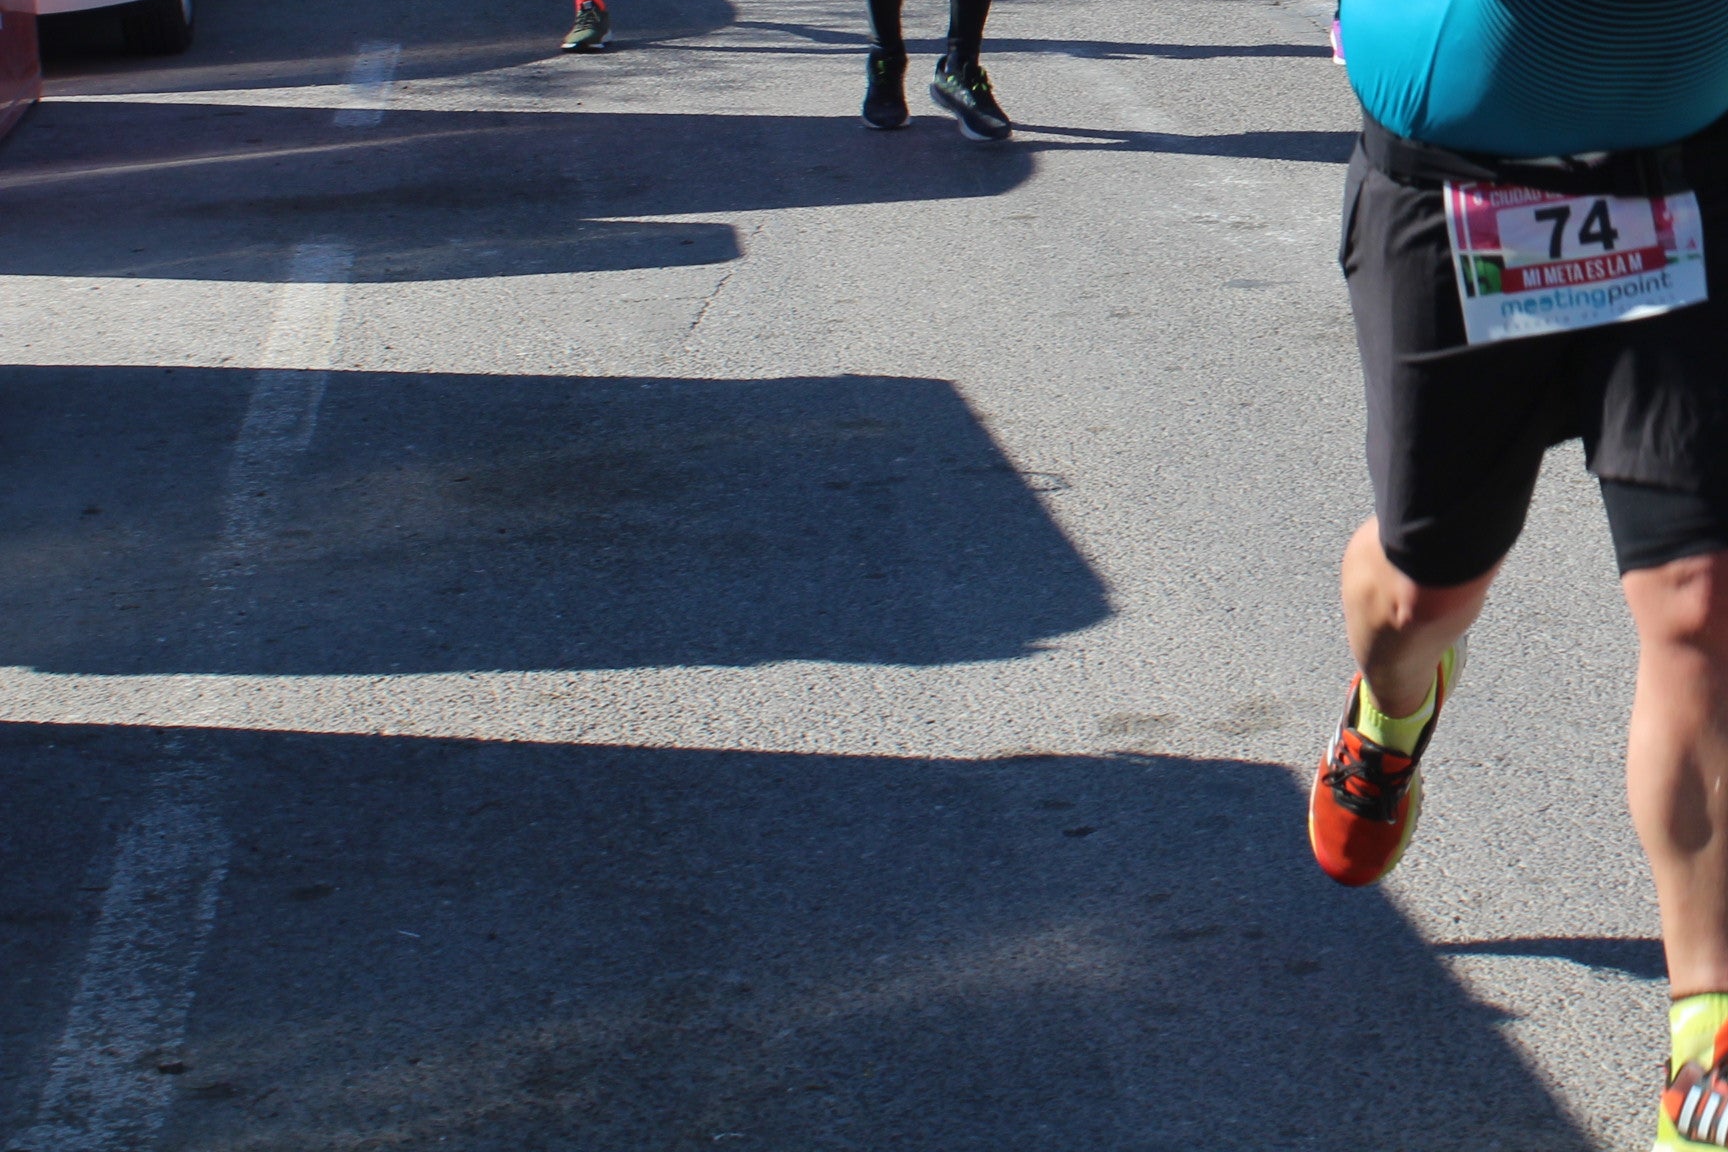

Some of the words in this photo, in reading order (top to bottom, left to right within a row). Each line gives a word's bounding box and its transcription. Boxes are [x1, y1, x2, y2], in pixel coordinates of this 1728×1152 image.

[1534, 199, 1619, 259] 74
[1501, 271, 1674, 319] meetingpoint
[1522, 268, 1541, 289] MI
[1544, 260, 1583, 286] META
[1586, 257, 1605, 280] ES
[1608, 254, 1627, 276] LA
